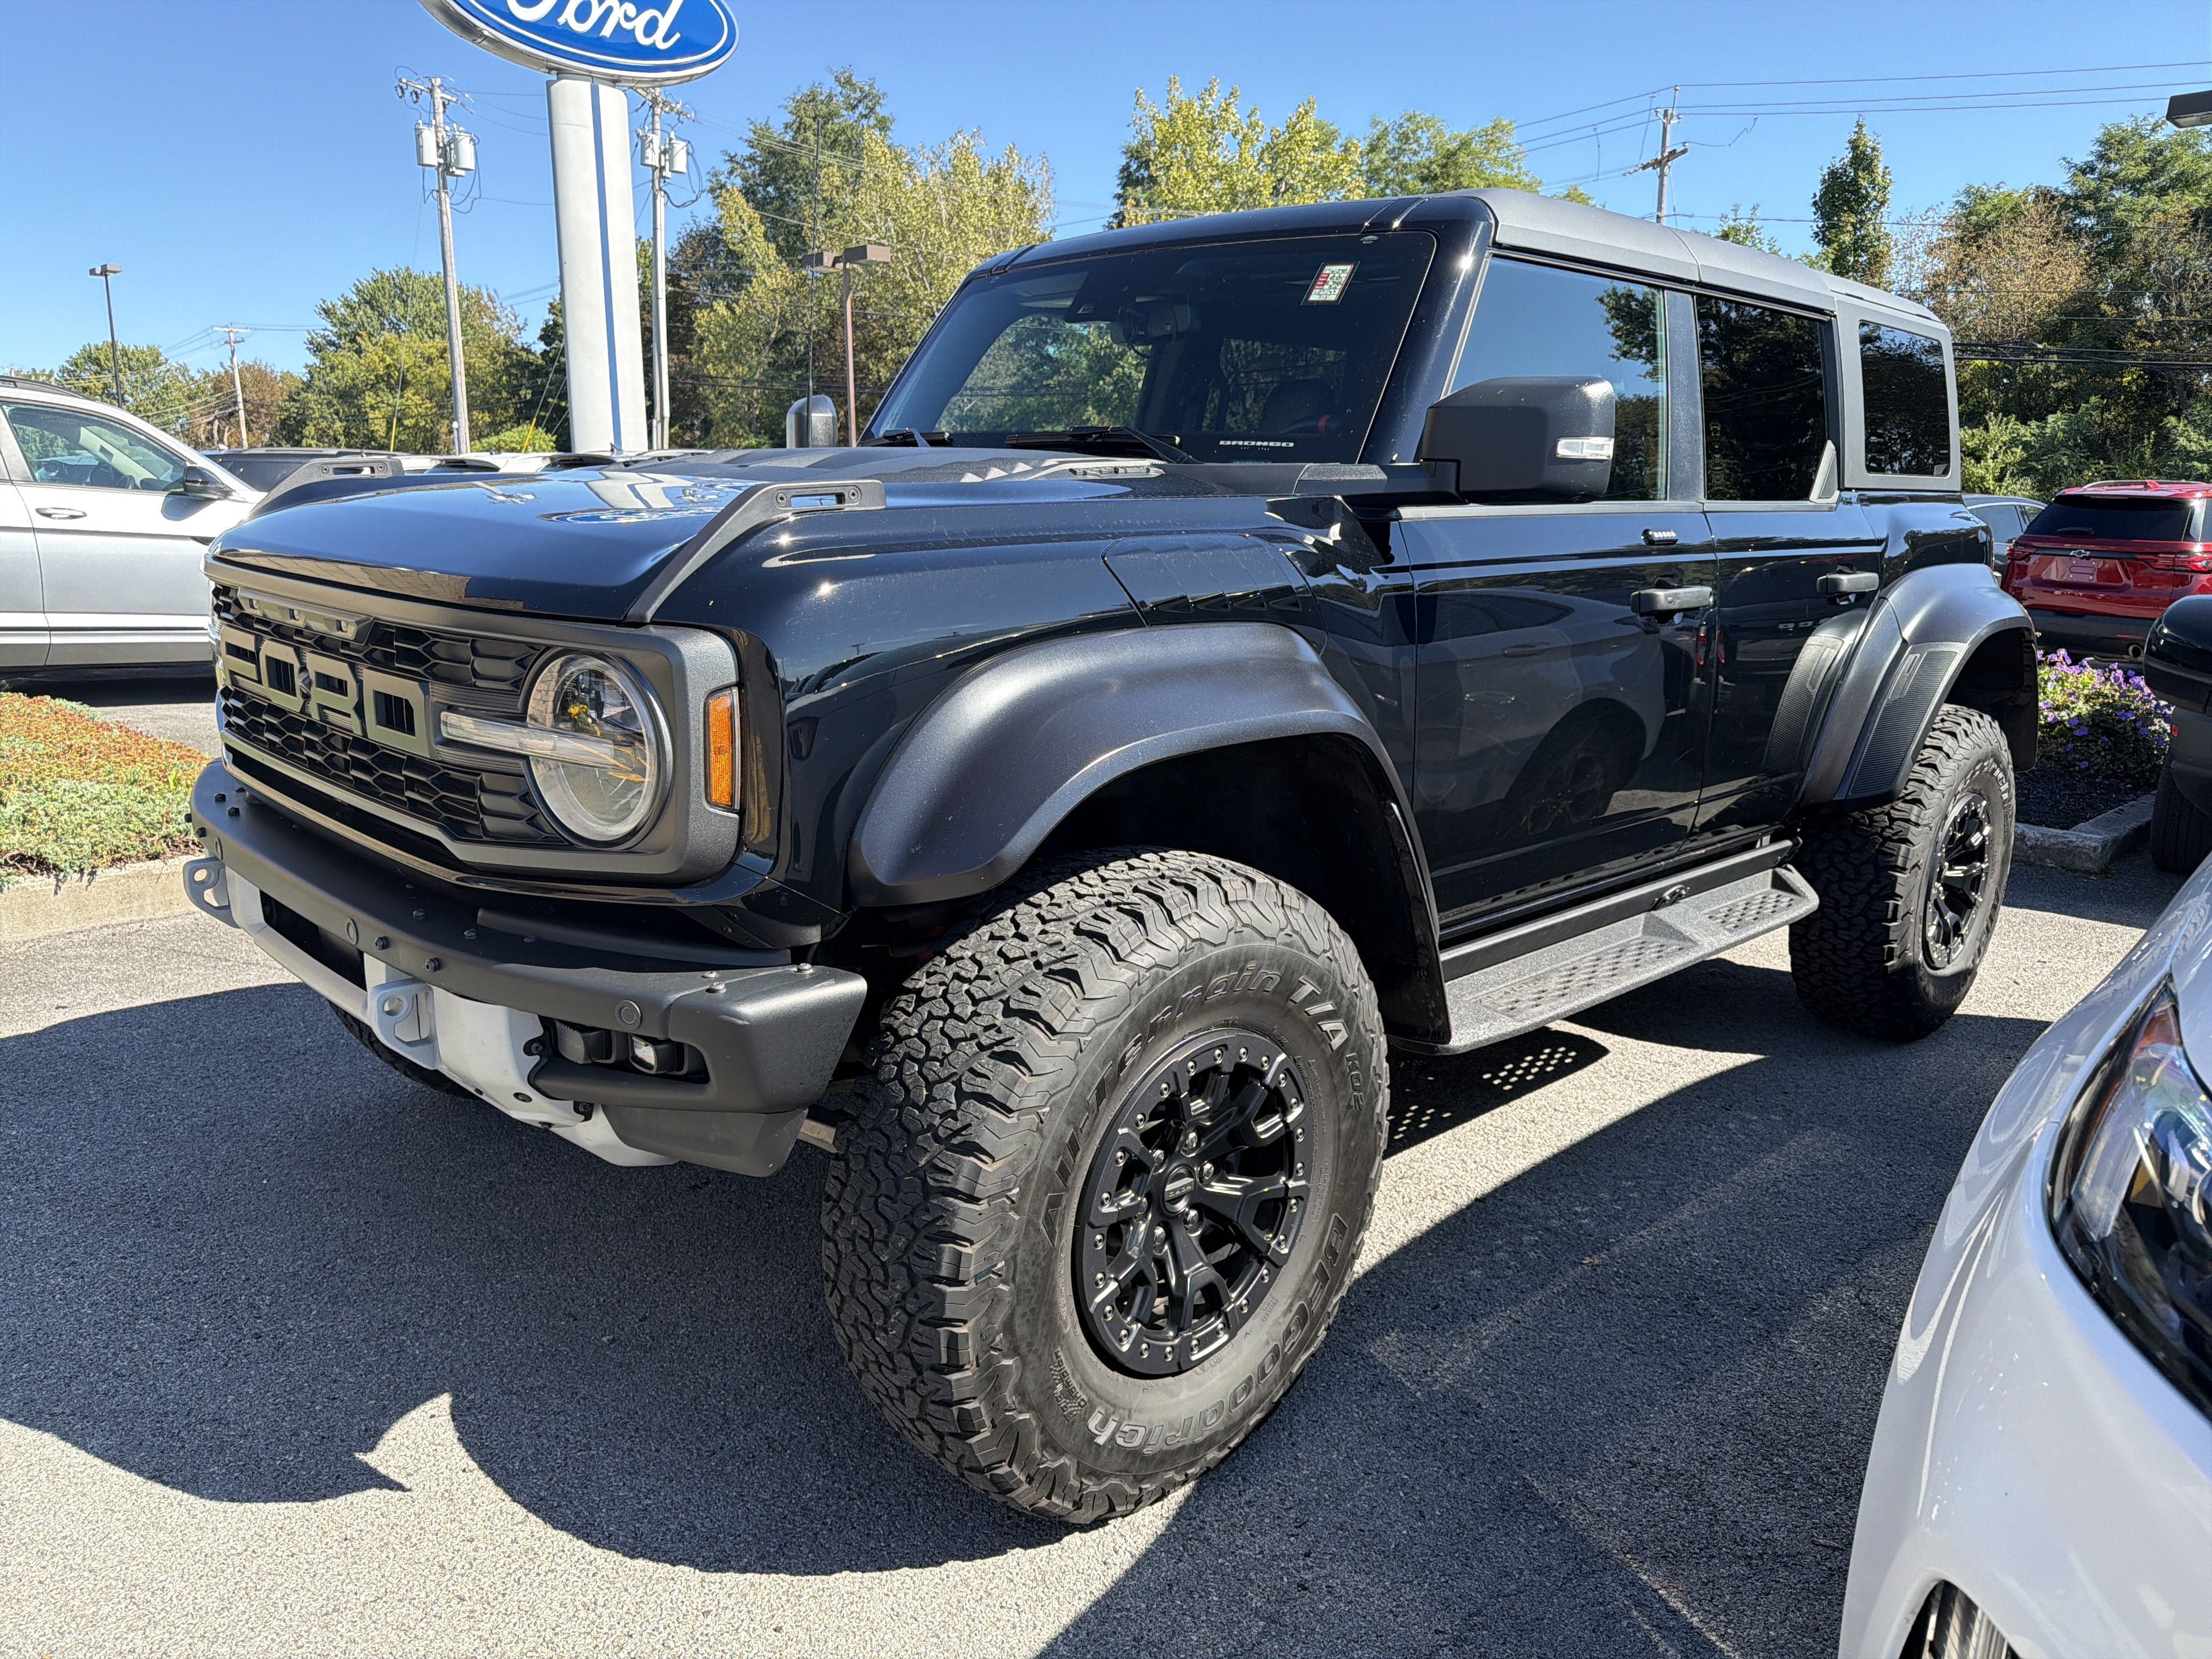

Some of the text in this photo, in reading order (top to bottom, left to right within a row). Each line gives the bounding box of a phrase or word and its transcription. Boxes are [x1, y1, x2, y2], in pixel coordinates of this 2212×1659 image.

[220, 625, 432, 758] FORD
[1042, 963, 1282, 1248] All-Terrain
[1289, 975, 1349, 1053] T/A
[1053, 1348, 1088, 1409] Champion
[1087, 1212, 1348, 1456] BFGoodrich
